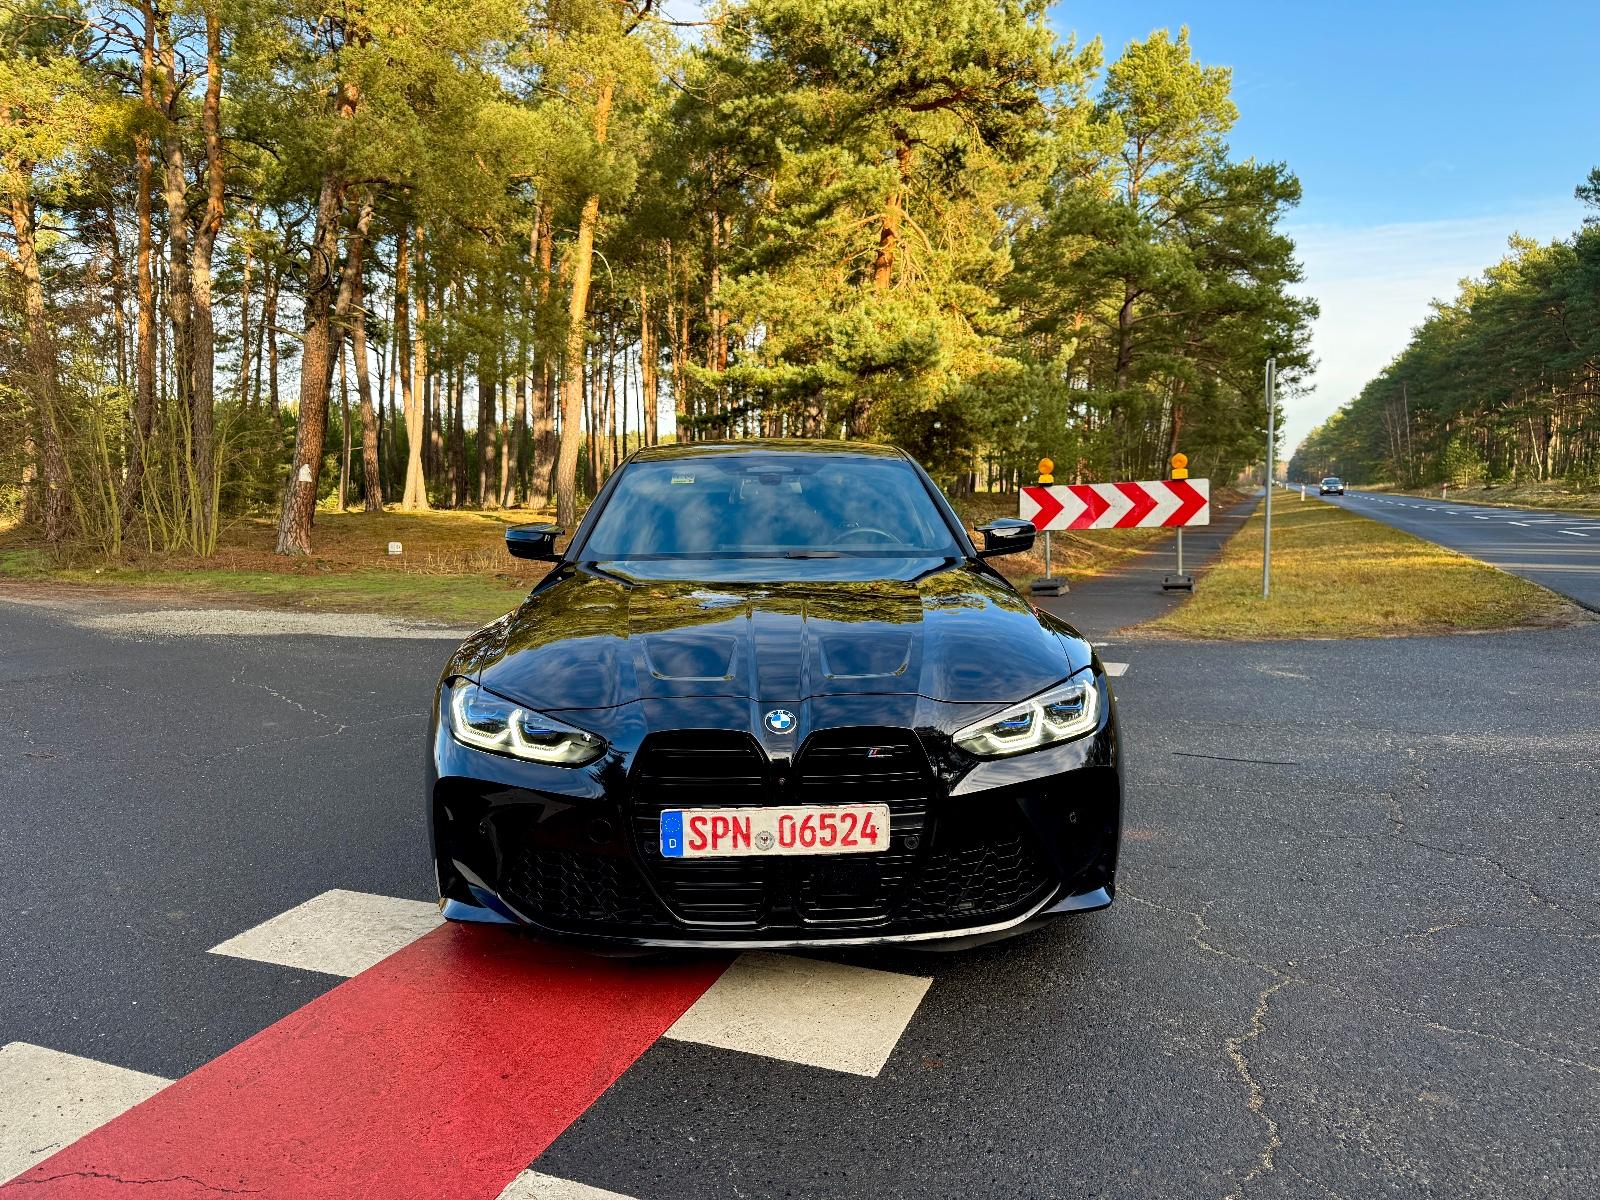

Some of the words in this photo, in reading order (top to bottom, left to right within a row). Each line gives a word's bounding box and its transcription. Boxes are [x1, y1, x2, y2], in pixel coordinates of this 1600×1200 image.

[669, 838, 677, 848] D
[688, 816, 751, 851] SPN
[778, 812, 878, 848] 06524
